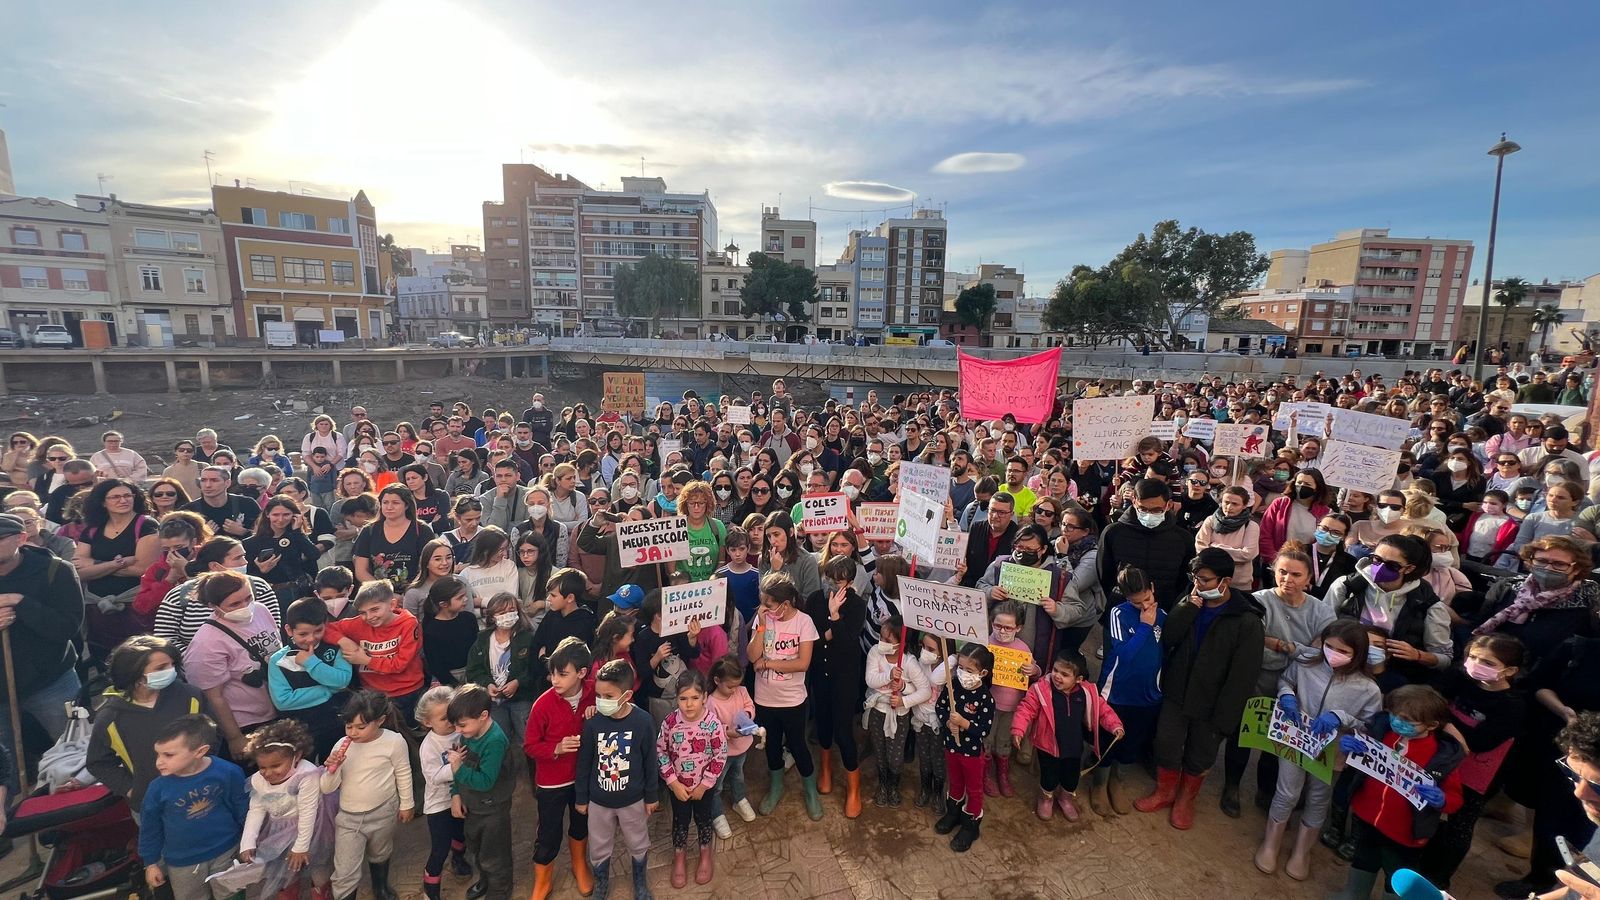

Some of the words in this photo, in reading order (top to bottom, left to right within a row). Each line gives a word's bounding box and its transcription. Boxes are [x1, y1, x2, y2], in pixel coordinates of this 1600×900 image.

[1104, 441, 1130, 450] FANG
[805, 498, 837, 508] COLES
[676, 518, 687, 528] LA
[864, 526, 896, 534] NFANTS
[623, 536, 650, 550] MEUA
[653, 530, 689, 545] ESCOLA
[904, 583, 931, 595] Volem
[905, 595, 959, 615] TORNAR
[669, 619, 678, 627] DE
[916, 614, 978, 638] ESCOLA
[363, 641, 384, 650] NEVER
[600, 777, 627, 792] SONIC
